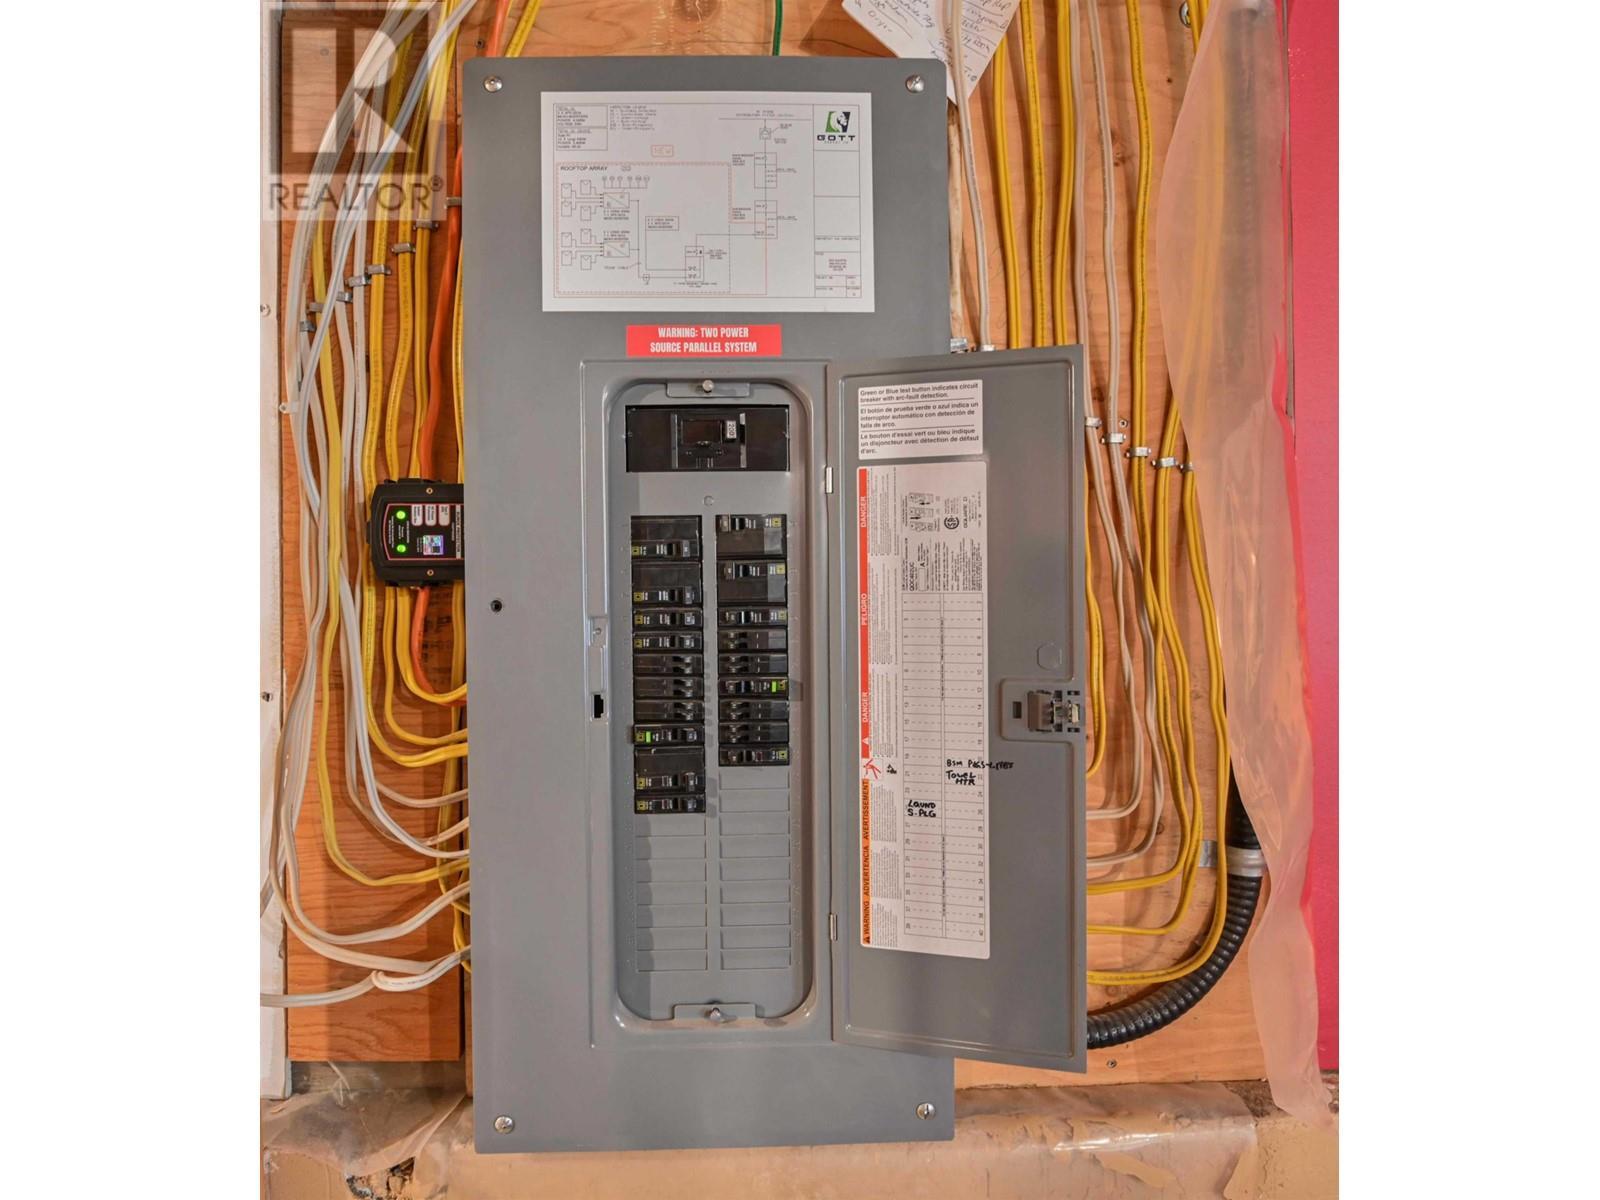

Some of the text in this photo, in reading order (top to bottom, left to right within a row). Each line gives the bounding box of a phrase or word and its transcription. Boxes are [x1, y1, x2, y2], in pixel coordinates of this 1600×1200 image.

[816, 134, 856, 142] GOTT
[658, 327, 749, 338] WARNING: TWO POWER
[650, 342, 757, 353] SOURCE PARALLEL SYSTEM
[860, 496, 868, 528] DANGER
[860, 593, 868, 626] PELIGRO
